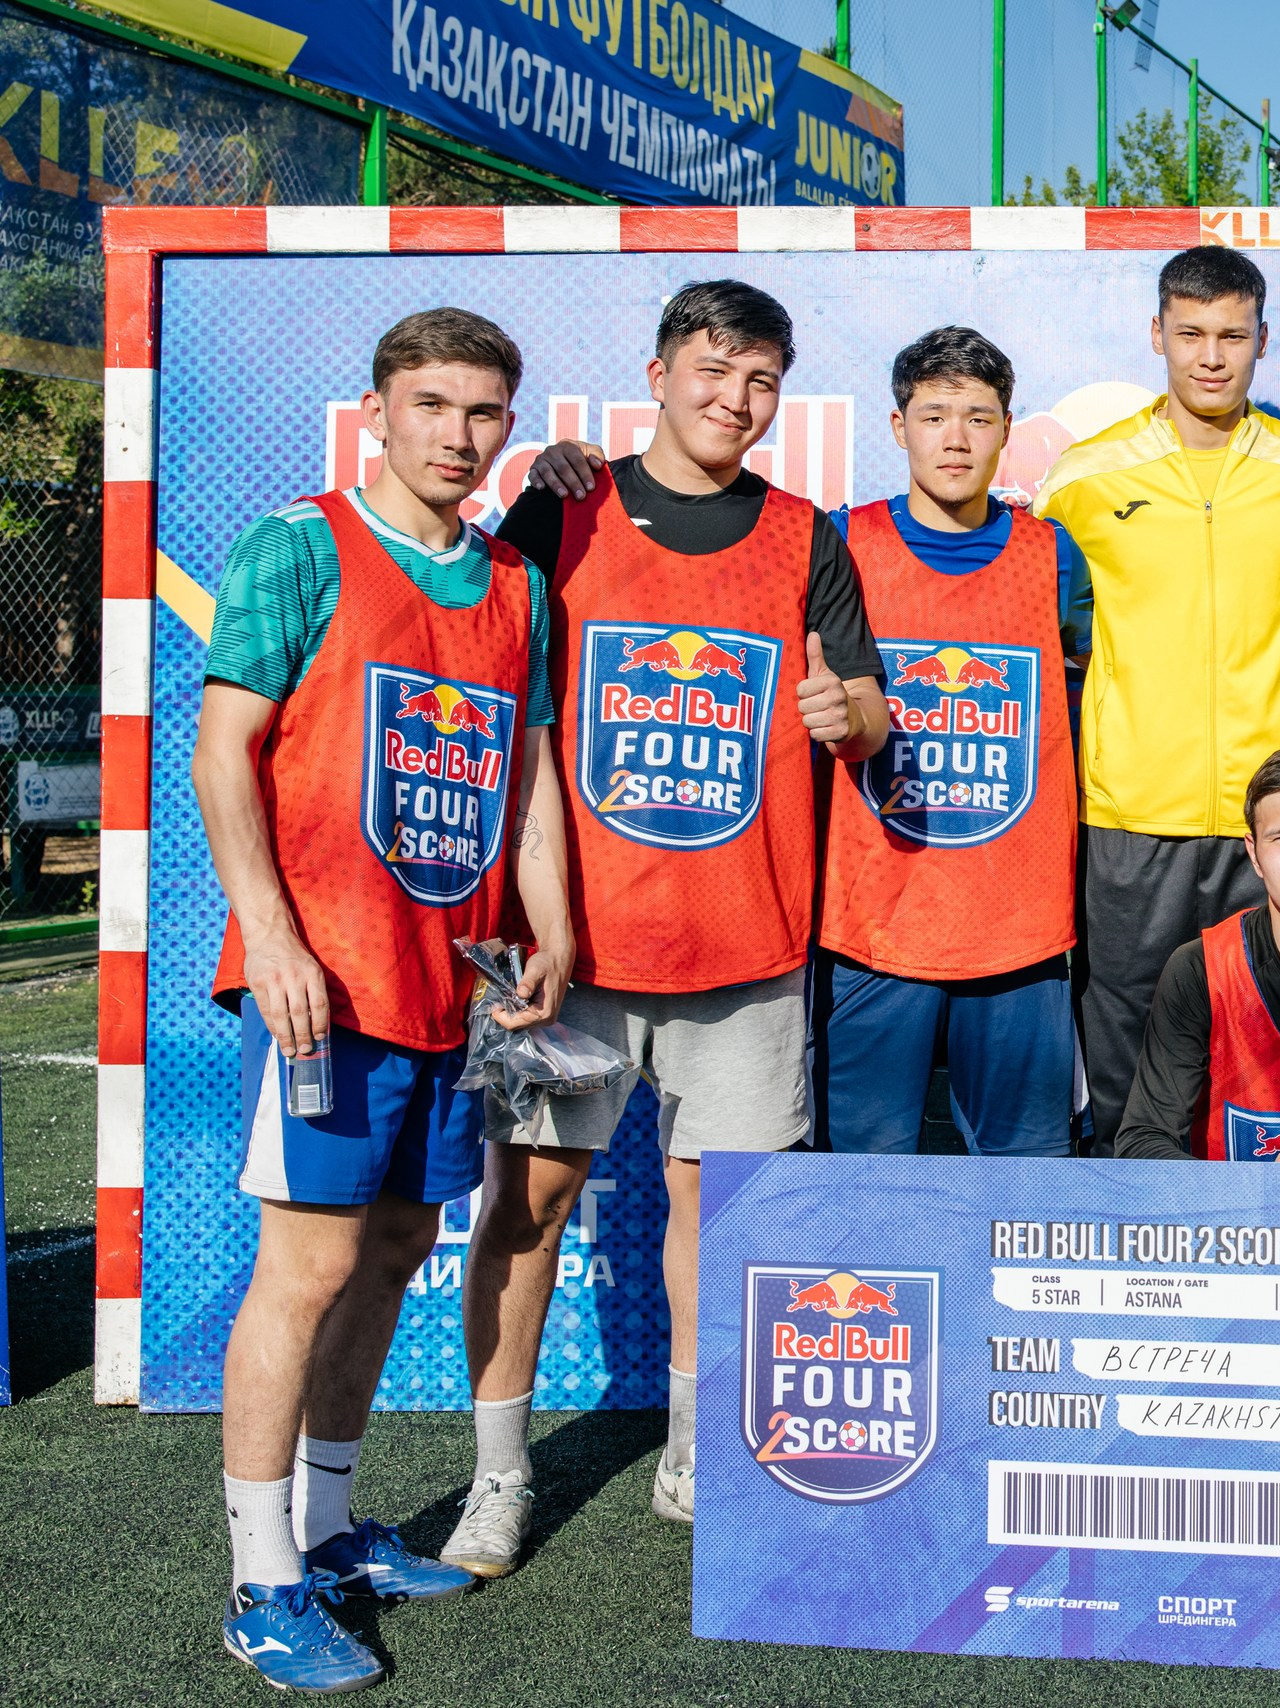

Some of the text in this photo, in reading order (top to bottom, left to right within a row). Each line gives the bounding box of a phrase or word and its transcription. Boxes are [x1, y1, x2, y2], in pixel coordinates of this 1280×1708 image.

[601, 84, 776, 206] ЧЕМПИОНАТЫ
[601, 683, 755, 736] Red Bull
[886, 696, 1021, 738] Red Bull
[385, 728, 503, 792] Red Bull
[614, 730, 743, 781] FOUR
[894, 740, 1008, 781] FOUR
[395, 781, 479, 835] FOUR
[993, 1221, 1045, 1259] RED
[1049, 1223, 1117, 1262] BULL
[1121, 1224, 1193, 1263] FOUR
[1197, 1226, 1215, 1263] 2
[1032, 1275, 1061, 1284] CLASS
[1032, 1289, 1081, 1306] 5 STAR
[1125, 1291, 1182, 1309] ASTANA
[1126, 1277, 1175, 1287] LOCATION
[1185, 1279, 1209, 1288] GATE
[773, 1322, 911, 1363] Red Bull
[991, 1337, 1060, 1373] TEAM
[773, 1365, 912, 1416] FOUR
[991, 1391, 1107, 1430] COUNTRY
[1016, 1596, 1120, 1611] sportarena
[1158, 1595, 1237, 1616] СПОРТ
[1158, 1614, 1237, 1627] ШРЁДИНГЕРА
